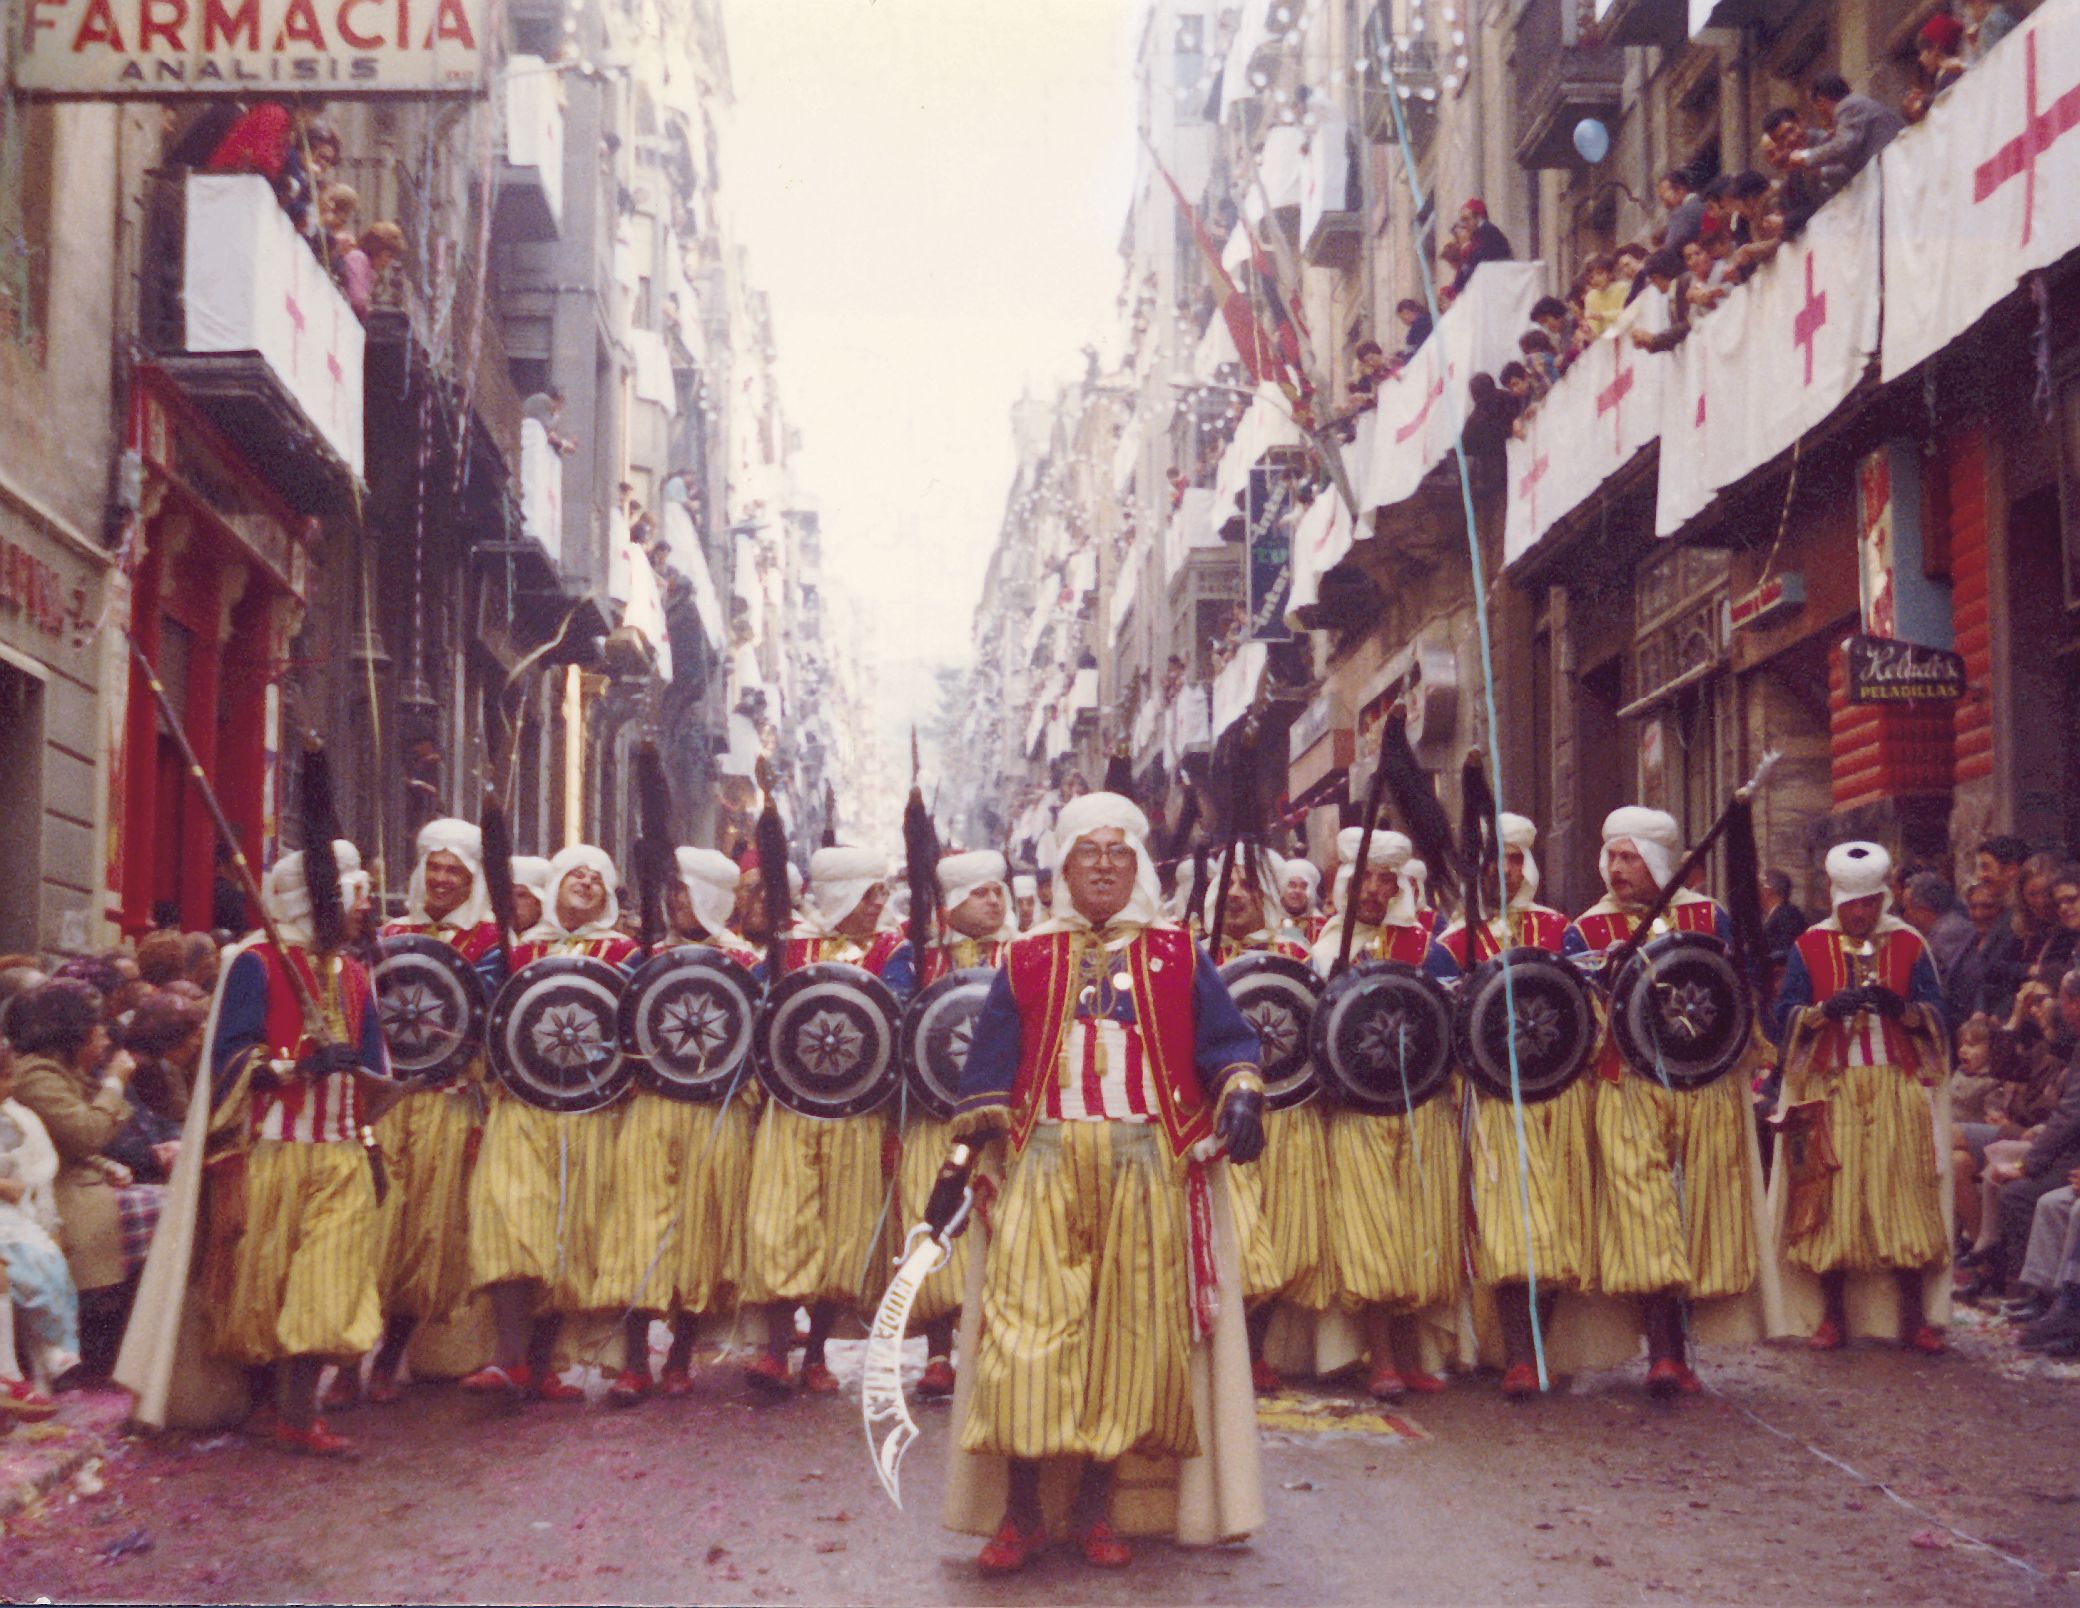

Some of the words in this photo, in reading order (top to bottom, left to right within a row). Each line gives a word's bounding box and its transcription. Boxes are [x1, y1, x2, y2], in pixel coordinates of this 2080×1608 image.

[21, 0, 477, 53] FARMACIA
[117, 57, 381, 82] ANALISIS
[1860, 685, 1958, 699] PELADILLAS
